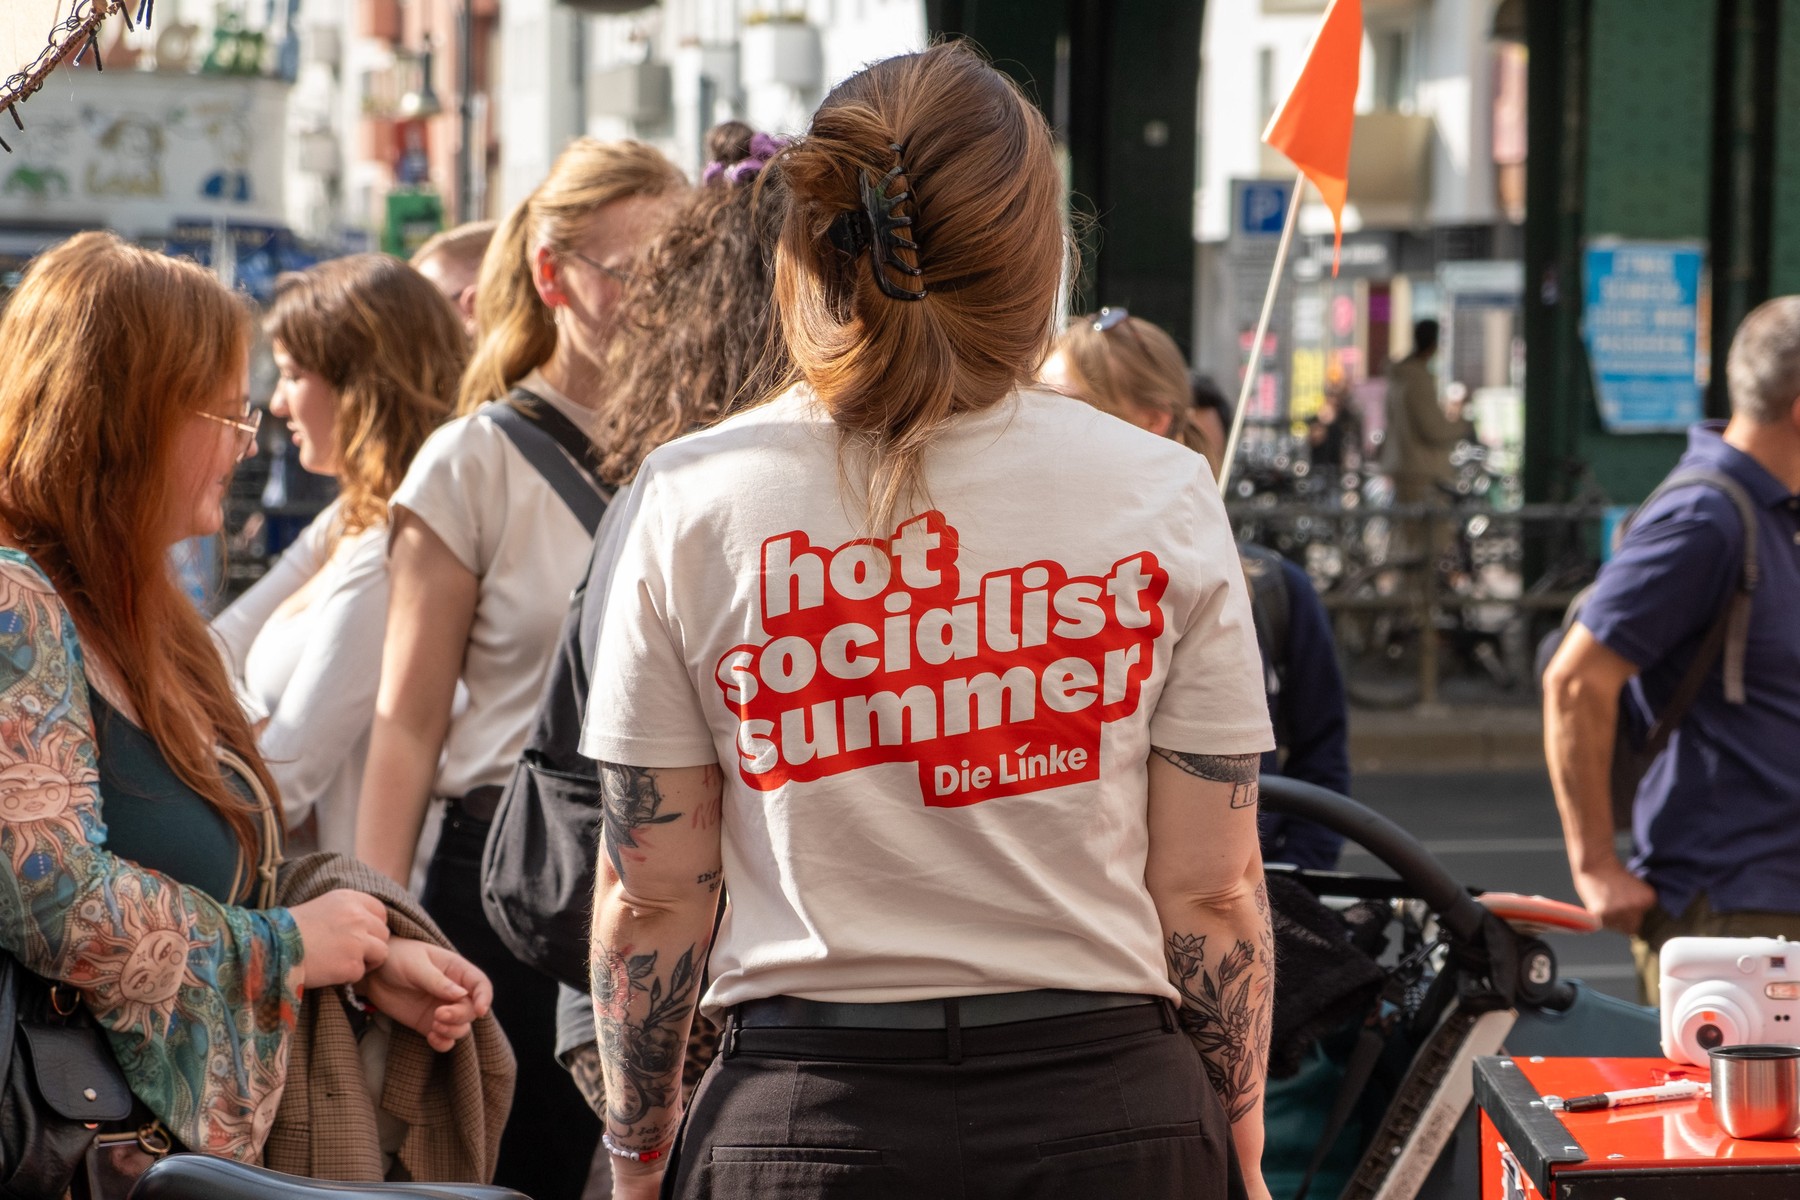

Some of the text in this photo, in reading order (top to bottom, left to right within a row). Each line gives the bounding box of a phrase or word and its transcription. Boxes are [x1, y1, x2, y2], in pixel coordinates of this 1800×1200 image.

[1250, 187, 1280, 228] P
[765, 516, 941, 619] hot
[717, 557, 1153, 706] socialist
[740, 643, 1141, 774] summer
[934, 759, 992, 796] Die
